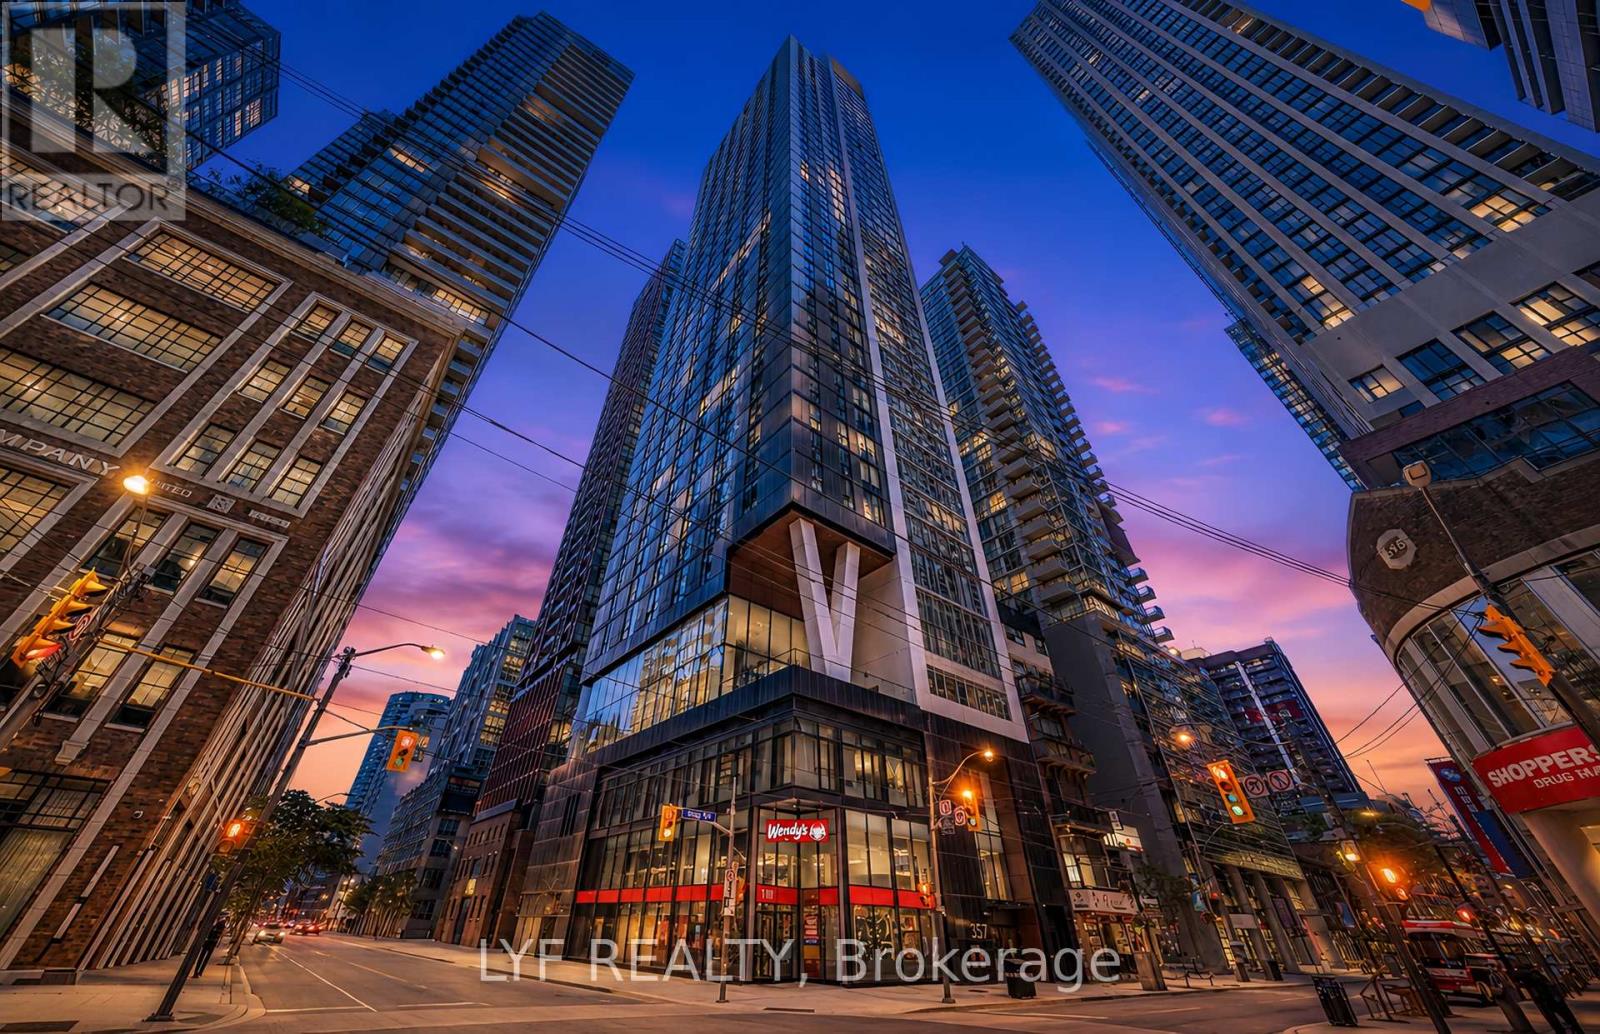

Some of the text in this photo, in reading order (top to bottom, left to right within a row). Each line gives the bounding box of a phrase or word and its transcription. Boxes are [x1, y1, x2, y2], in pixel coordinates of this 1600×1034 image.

[1533, 772, 1575, 789] DRUG
[768, 822, 808, 840] Wendy's
[970, 923, 987, 939] 357
